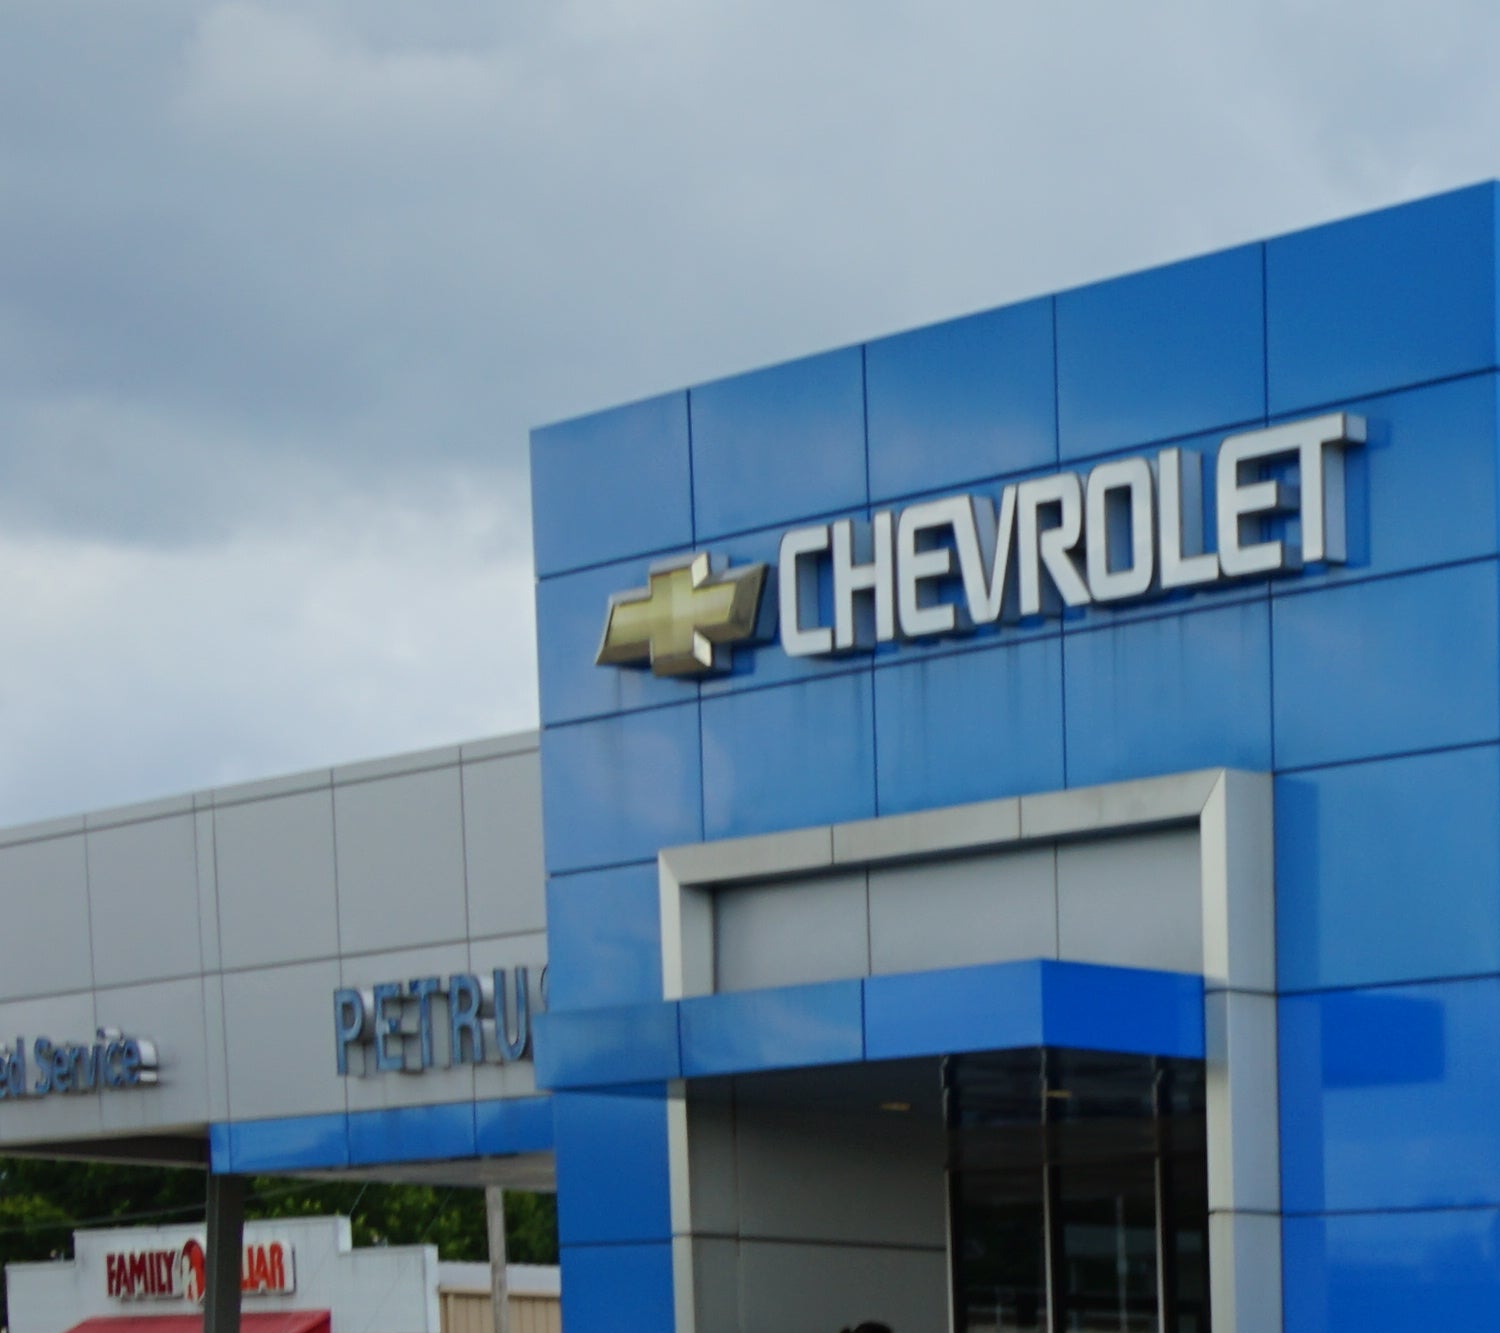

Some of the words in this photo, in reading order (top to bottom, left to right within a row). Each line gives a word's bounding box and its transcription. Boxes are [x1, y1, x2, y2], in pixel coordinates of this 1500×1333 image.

[778, 412, 1367, 658] CHEVROLET
[33, 1026, 157, 1096] Service
[333, 966, 547, 1076] PETRU
[106, 1248, 176, 1298] FAMILY
